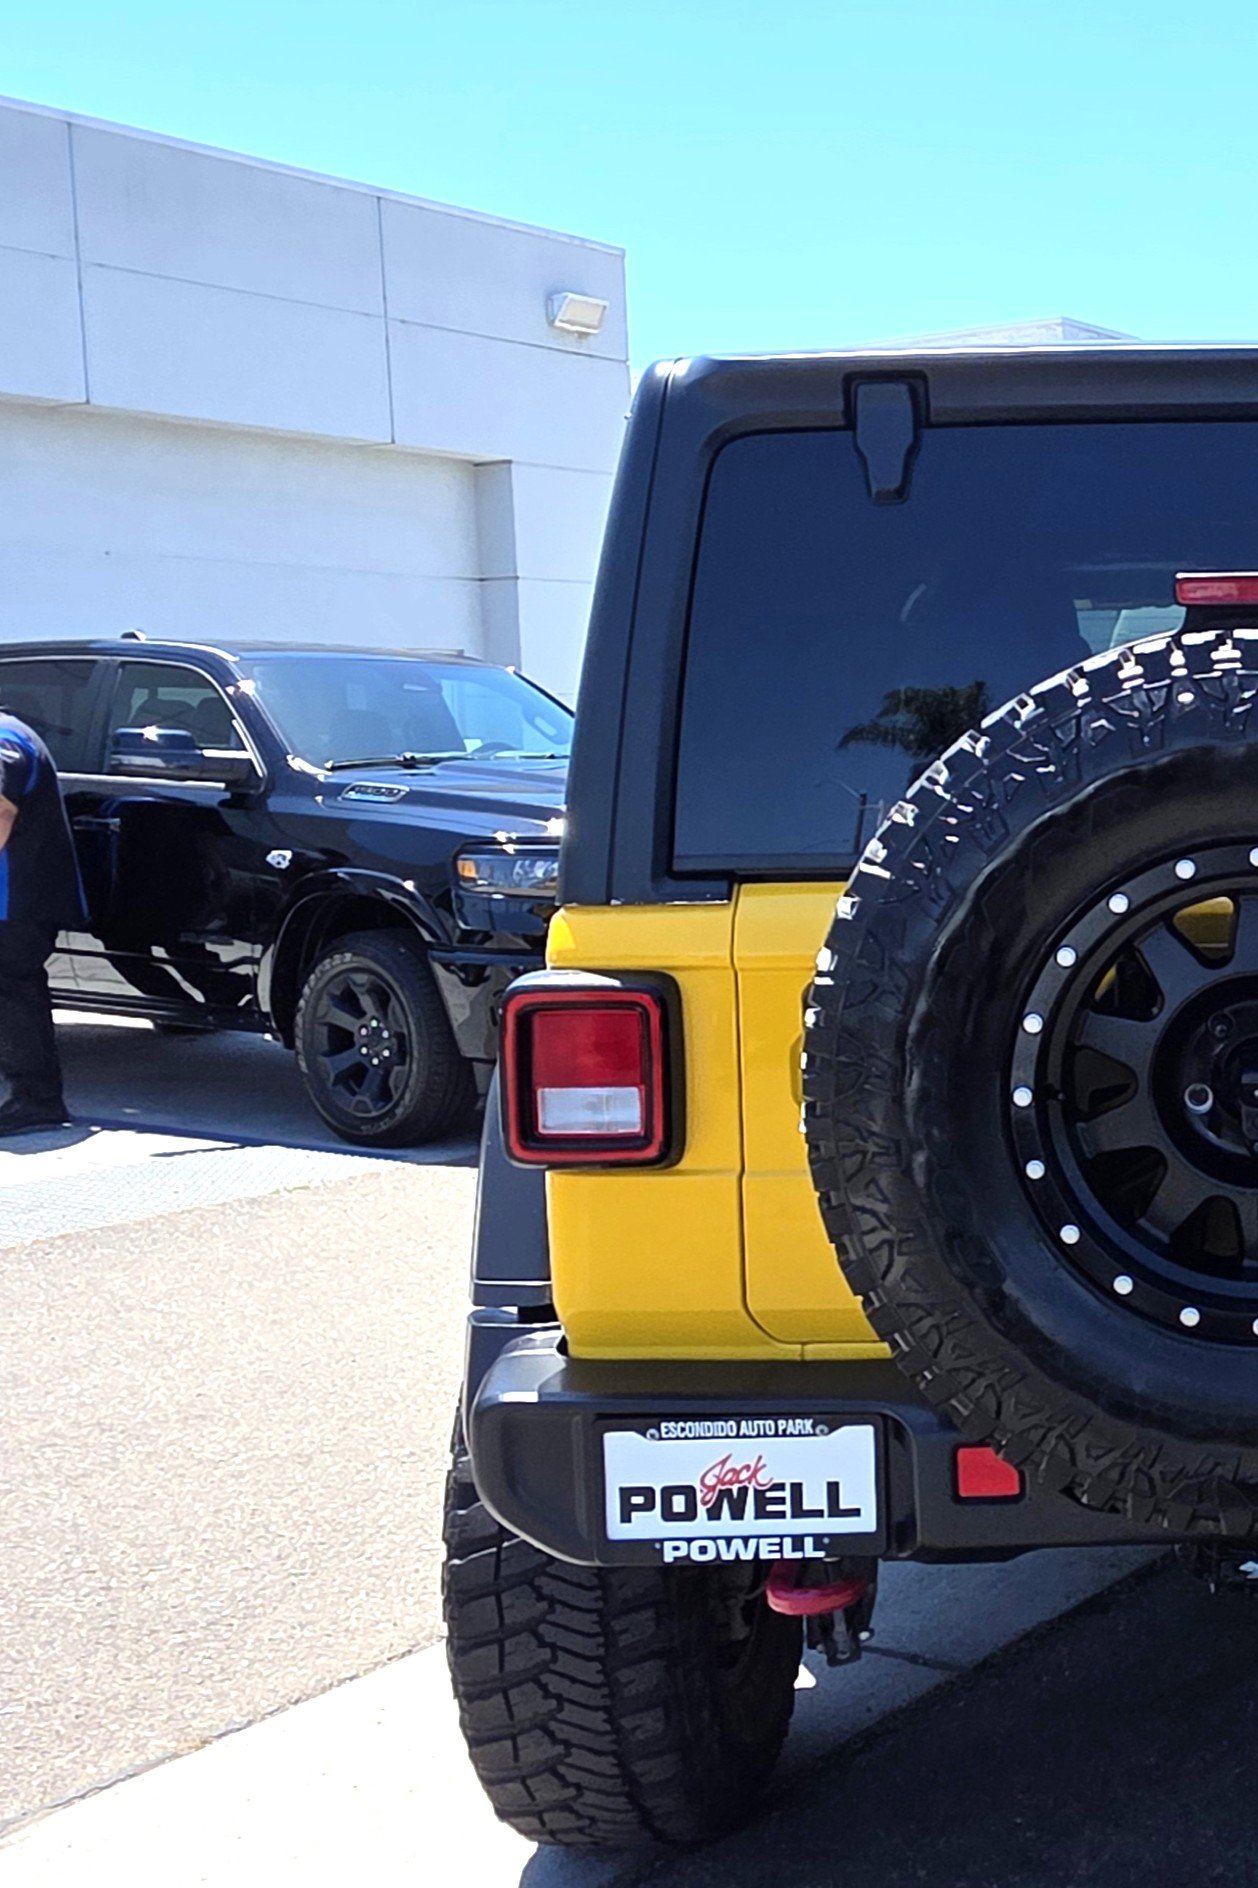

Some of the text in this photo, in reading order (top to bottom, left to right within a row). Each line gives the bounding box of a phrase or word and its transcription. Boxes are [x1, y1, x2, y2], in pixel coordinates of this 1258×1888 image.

[660, 1419, 814, 1439] ESCONDIDO AUTO PARK
[700, 1453, 774, 1507] Jack
[619, 1481, 861, 1523] POWELL
[663, 1537, 826, 1563] POWELL
